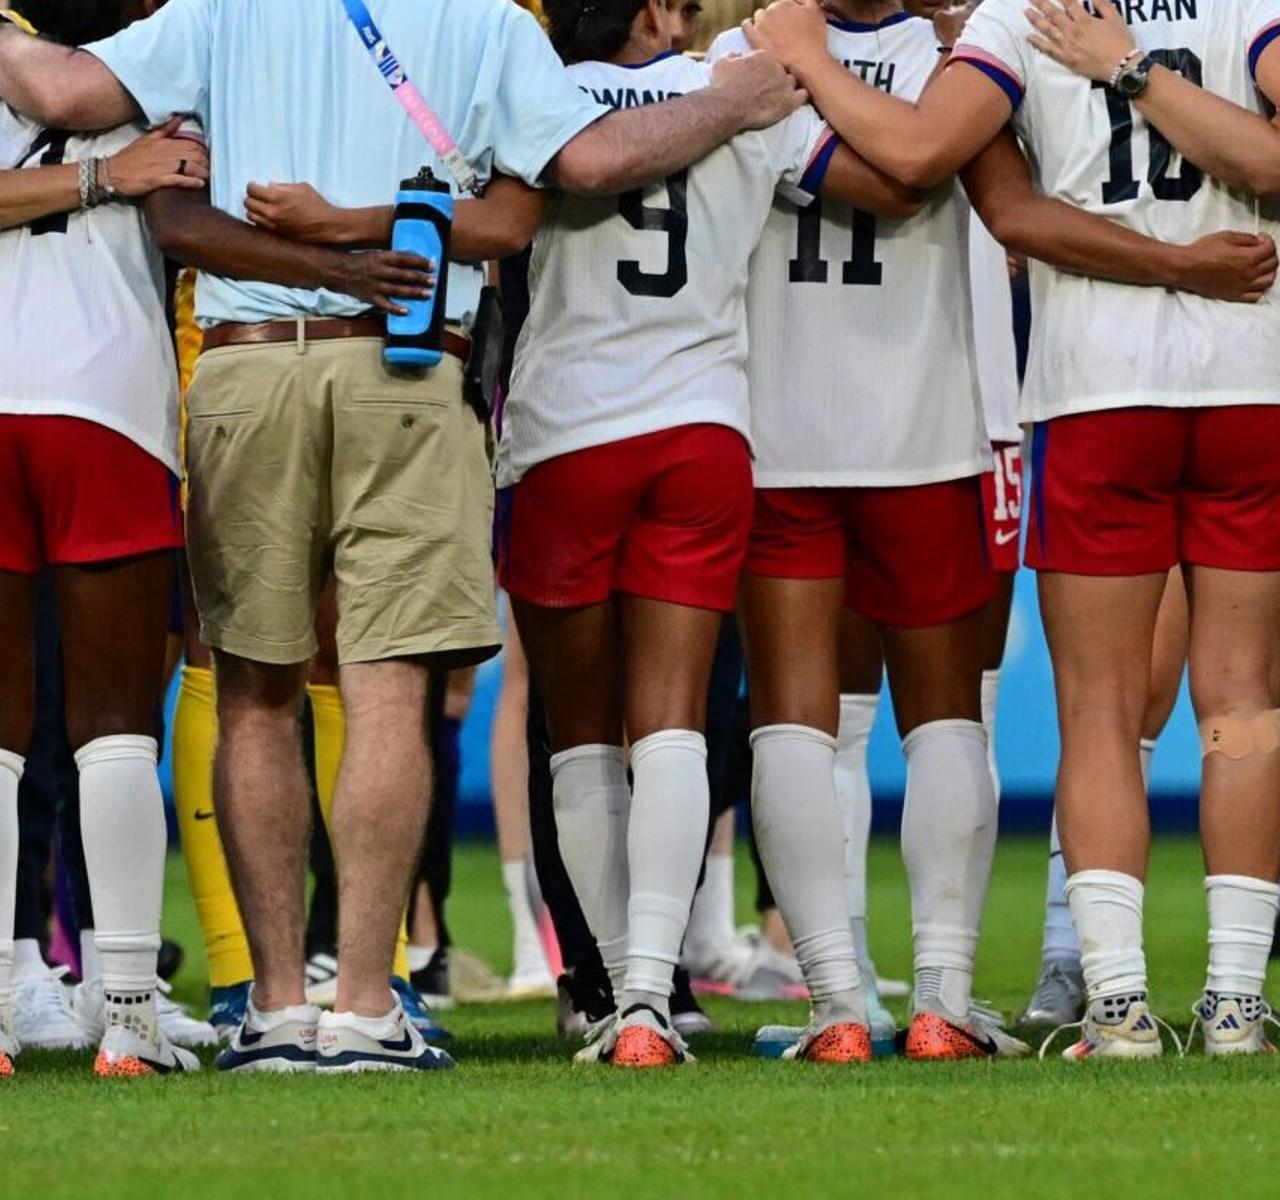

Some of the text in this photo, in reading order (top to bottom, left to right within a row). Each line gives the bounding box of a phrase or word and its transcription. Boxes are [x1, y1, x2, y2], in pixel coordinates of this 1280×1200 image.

[1091, 48, 1203, 204] 10
[616, 172, 687, 297] 9
[789, 198, 882, 285] 11
[993, 448, 1021, 520] 15
